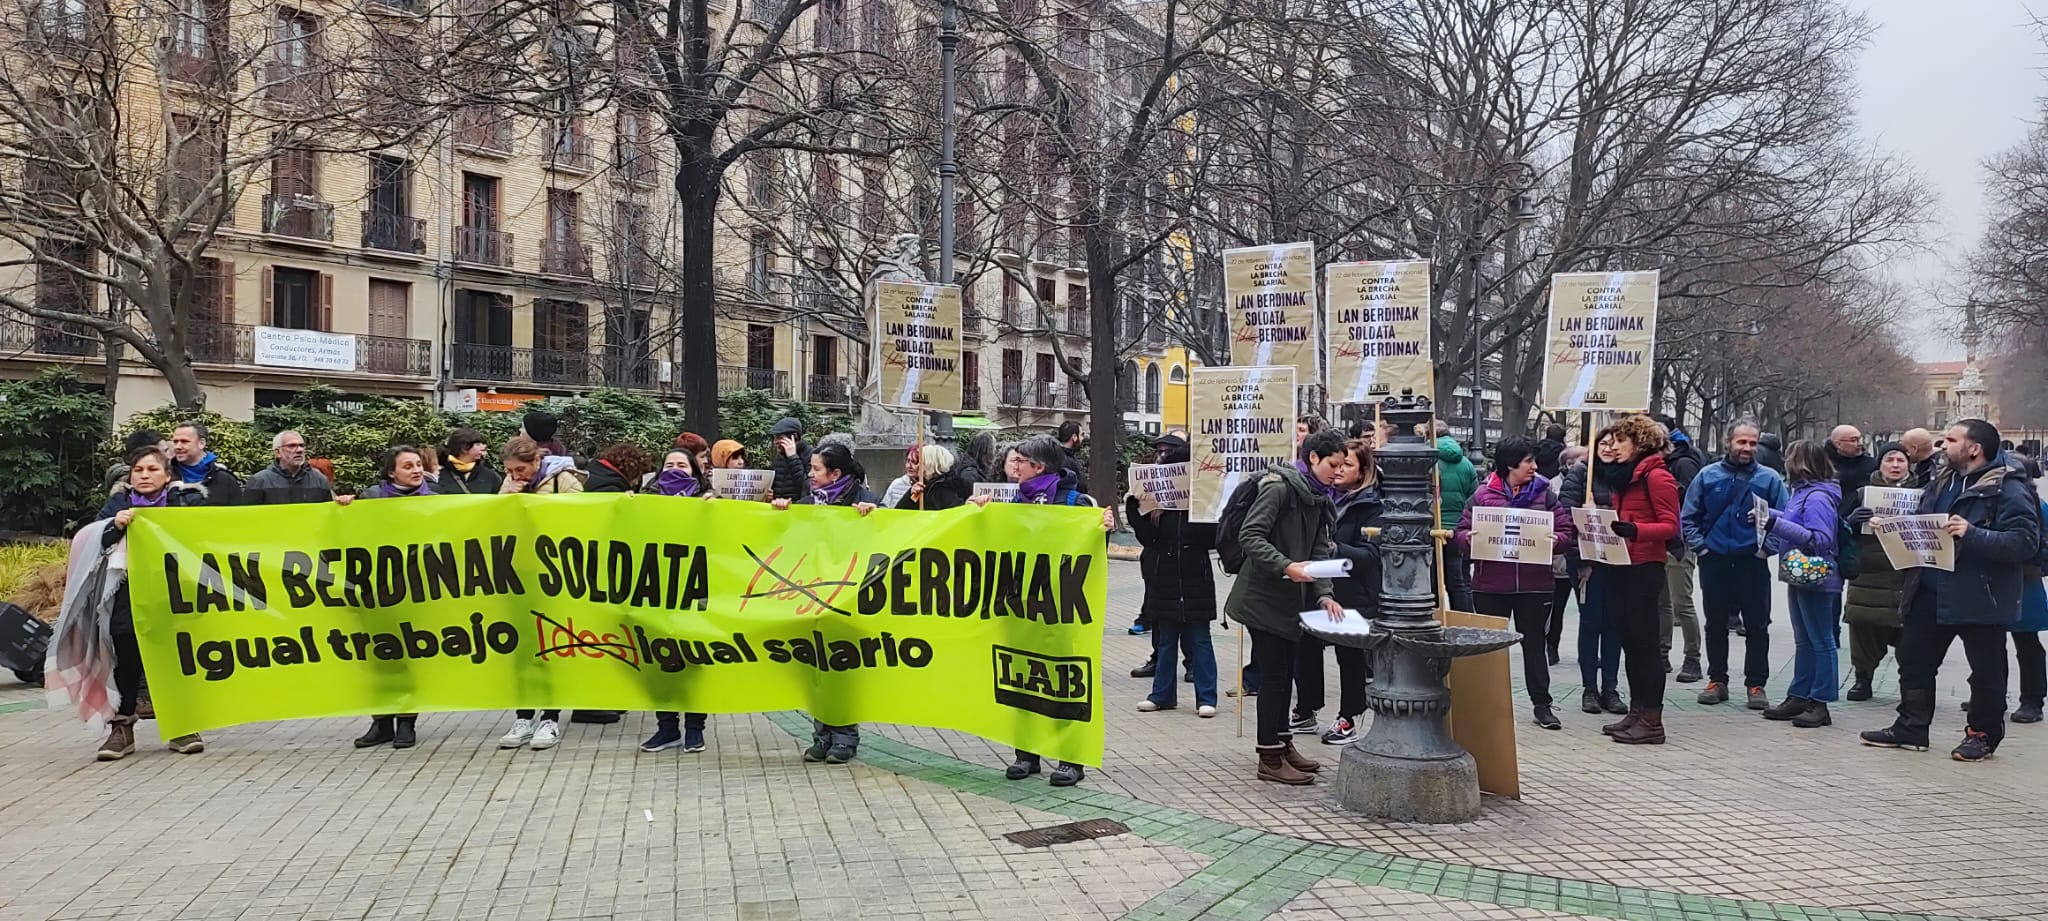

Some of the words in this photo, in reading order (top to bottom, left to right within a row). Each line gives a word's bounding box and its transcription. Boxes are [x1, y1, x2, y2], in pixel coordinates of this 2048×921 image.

[1254, 262, 1283, 271] CONTRA
[1260, 271, 1287, 279] BRECHA
[1253, 279, 1287, 287] SALARIAL
[905, 296, 934, 304] CONTRA
[1235, 294, 1253, 309] LAN
[1257, 291, 1306, 308] BERDINAK
[1360, 293, 1397, 301] SALARIAL
[904, 311, 935, 319] SALARIAL
[911, 304, 938, 312] BRECHA
[1338, 308, 1359, 323] LAN
[1363, 306, 1419, 322] BERDINAK
[1245, 310, 1286, 326] SOLDATA
[1559, 317, 1582, 331] LAN
[1585, 316, 1644, 331] BERDINAK
[260, 331, 291, 341] Centro
[886, 322, 904, 336] LAN
[907, 324, 954, 341] BERDINAK
[1258, 326, 1307, 342] BERDINAK
[1348, 325, 1396, 341] SOLDATA
[895, 339, 934, 355] SOLDATA
[1569, 334, 1618, 348] SOLDATA
[1363, 341, 1420, 357] BERDINAK
[907, 355, 954, 372] BERDINAK
[1583, 351, 1641, 365] BERDINAK
[1369, 384, 1389, 392] LAB
[913, 392, 929, 400] LAB
[1585, 392, 1606, 400] LAB
[1201, 419, 1222, 435] LAN
[1226, 417, 1284, 434] BERDINAK
[1211, 438, 1260, 454] SOLDATA
[1135, 469, 1149, 480] LAN
[1150, 465, 1187, 479] BERDINAK
[1142, 480, 1175, 492] SOLDATA
[1155, 489, 1190, 502] BERDINA
[1477, 513, 1504, 523] SEKTORE
[1505, 515, 1549, 526] FEMINIZATUAK
[1880, 524, 1897, 534] ZOR
[1896, 520, 1941, 530] PATRIARKALA
[1488, 536, 1536, 547] PREKARIZAZIOA
[1904, 541, 1943, 551] PATRONALA
[164, 551, 267, 614] LAN
[281, 534, 526, 609] BERDINAK
[535, 534, 708, 611] SOLDATA
[858, 547, 1093, 625] BERDINAK
[176, 626, 321, 681] Igual
[326, 612, 520, 664] trabajo
[634, 625, 758, 673] igual
[763, 629, 934, 673] salario
[998, 653, 1087, 699] LAB
